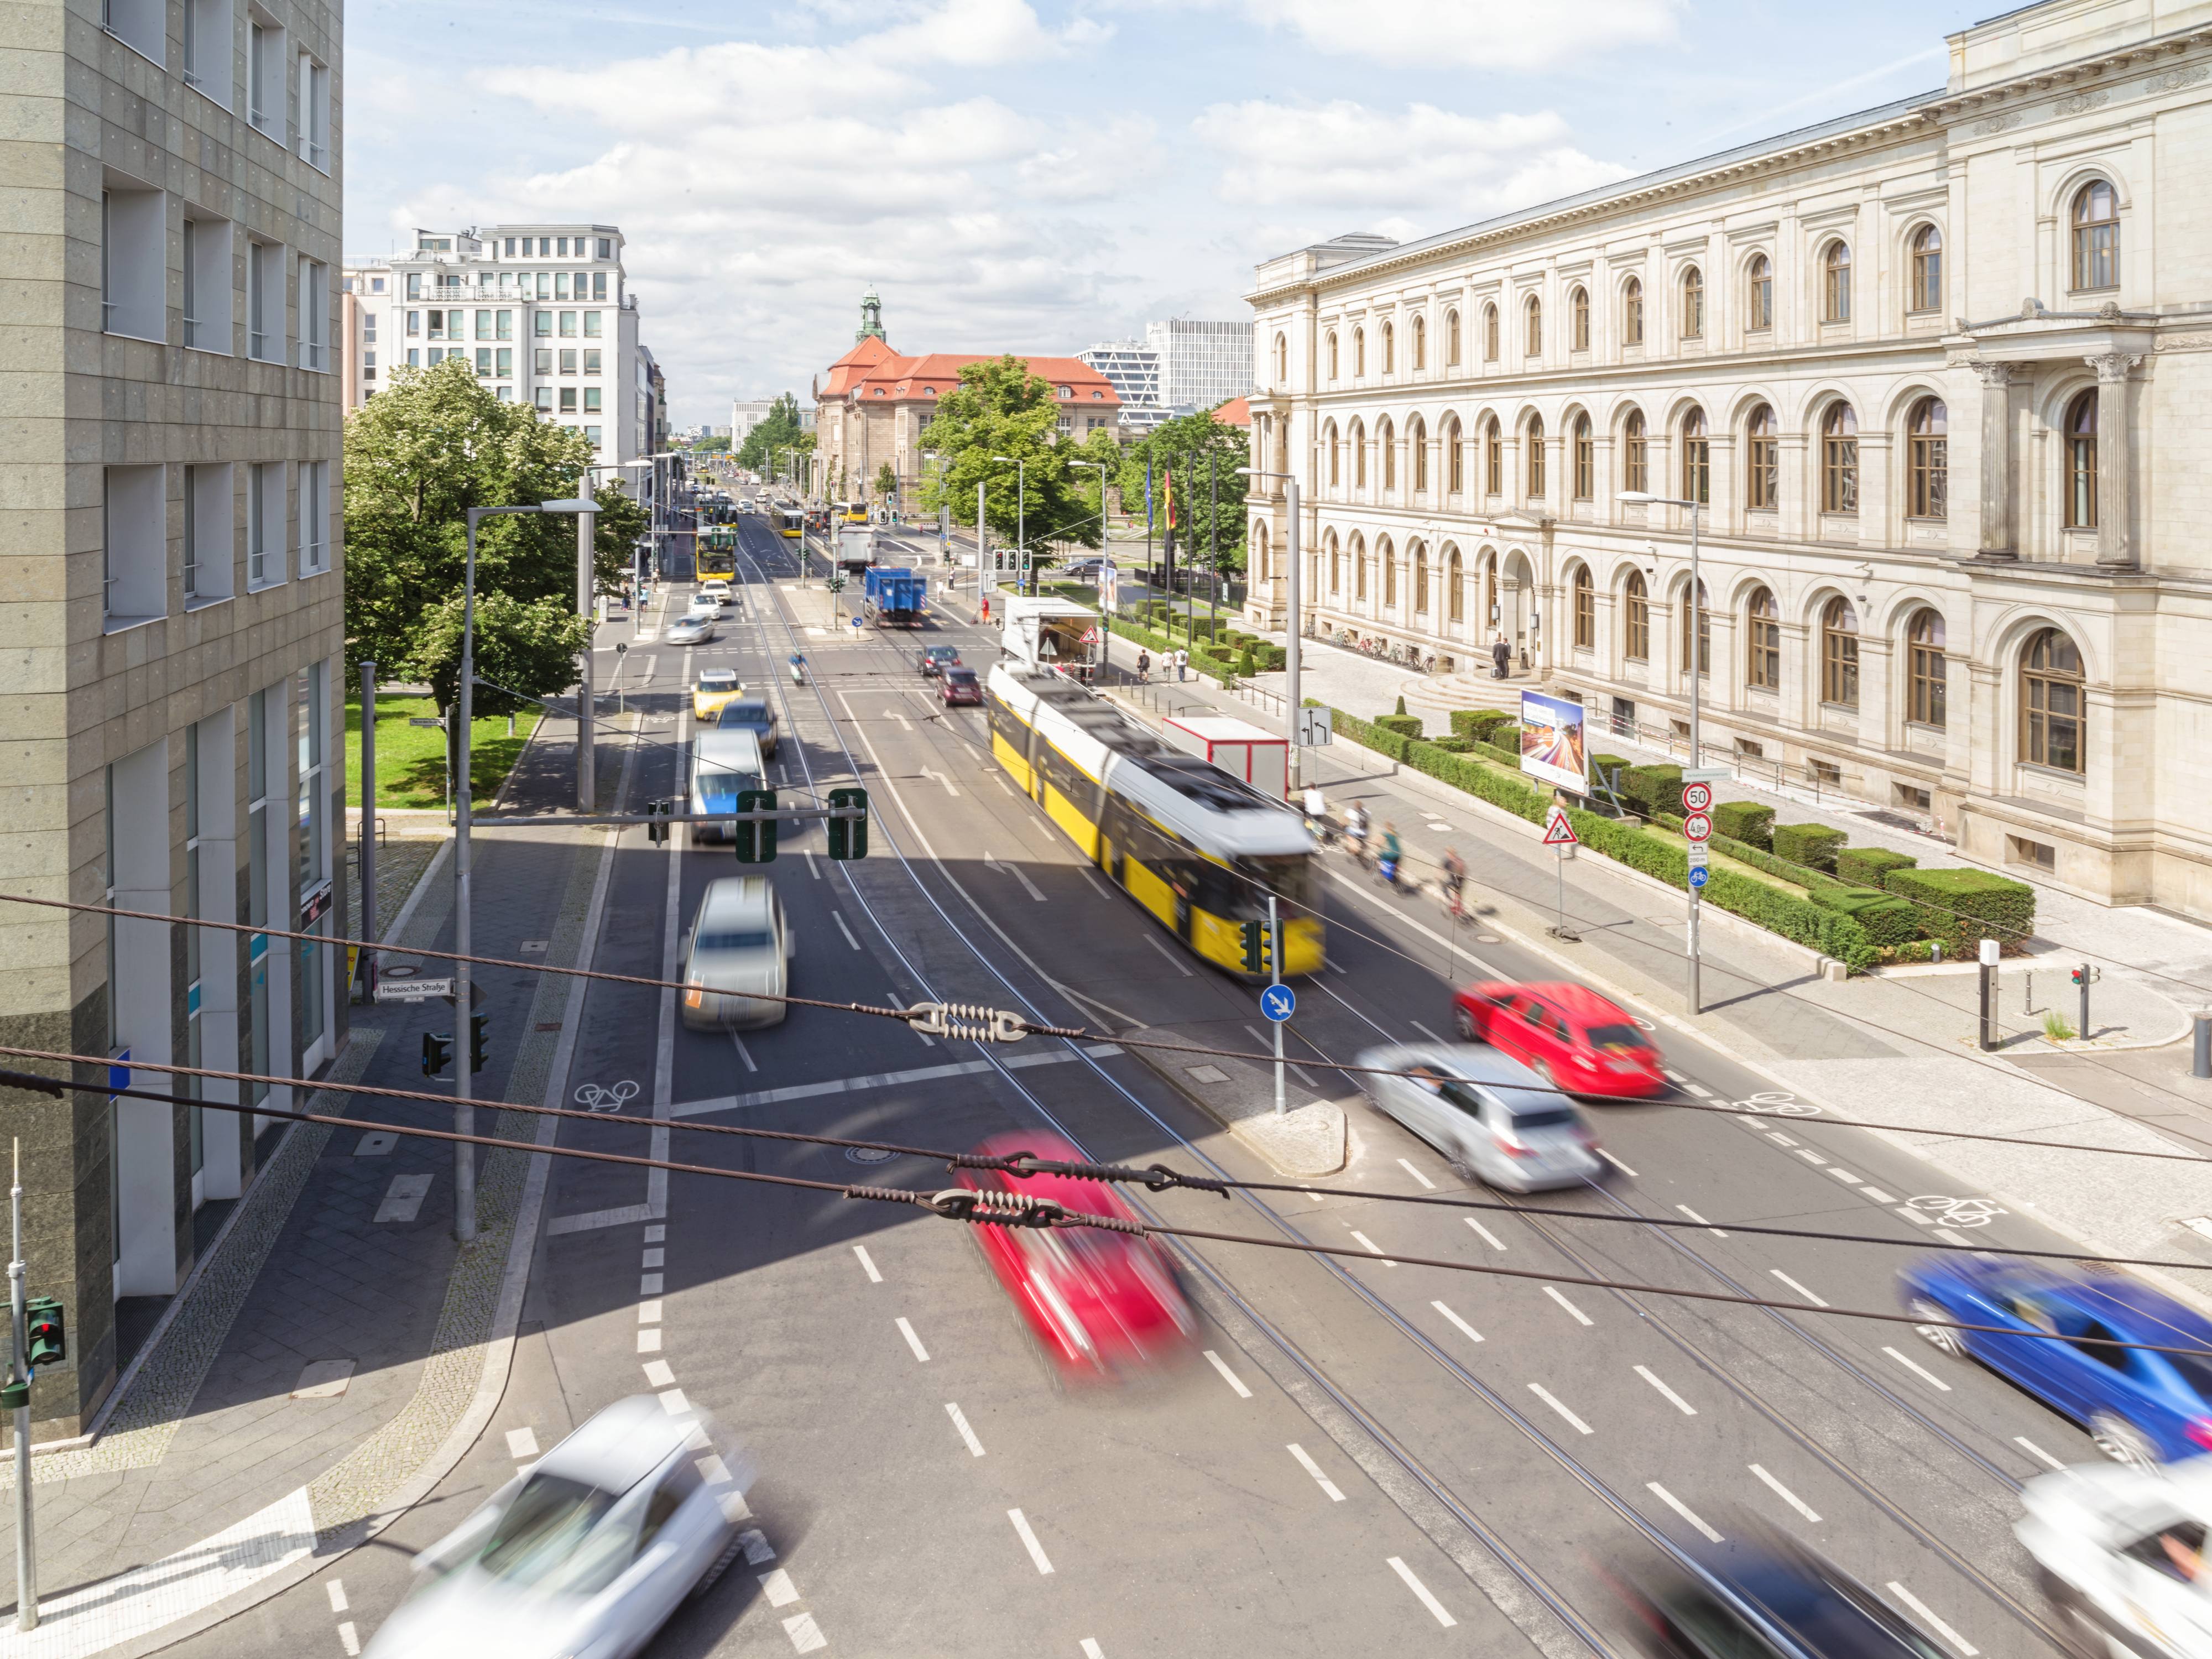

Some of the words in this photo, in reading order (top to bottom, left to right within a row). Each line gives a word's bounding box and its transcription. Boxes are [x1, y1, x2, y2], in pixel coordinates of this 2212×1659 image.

[1691, 791, 1706, 804] 50
[383, 984, 420, 993] Hessische
[422, 983, 445, 992] Straße
